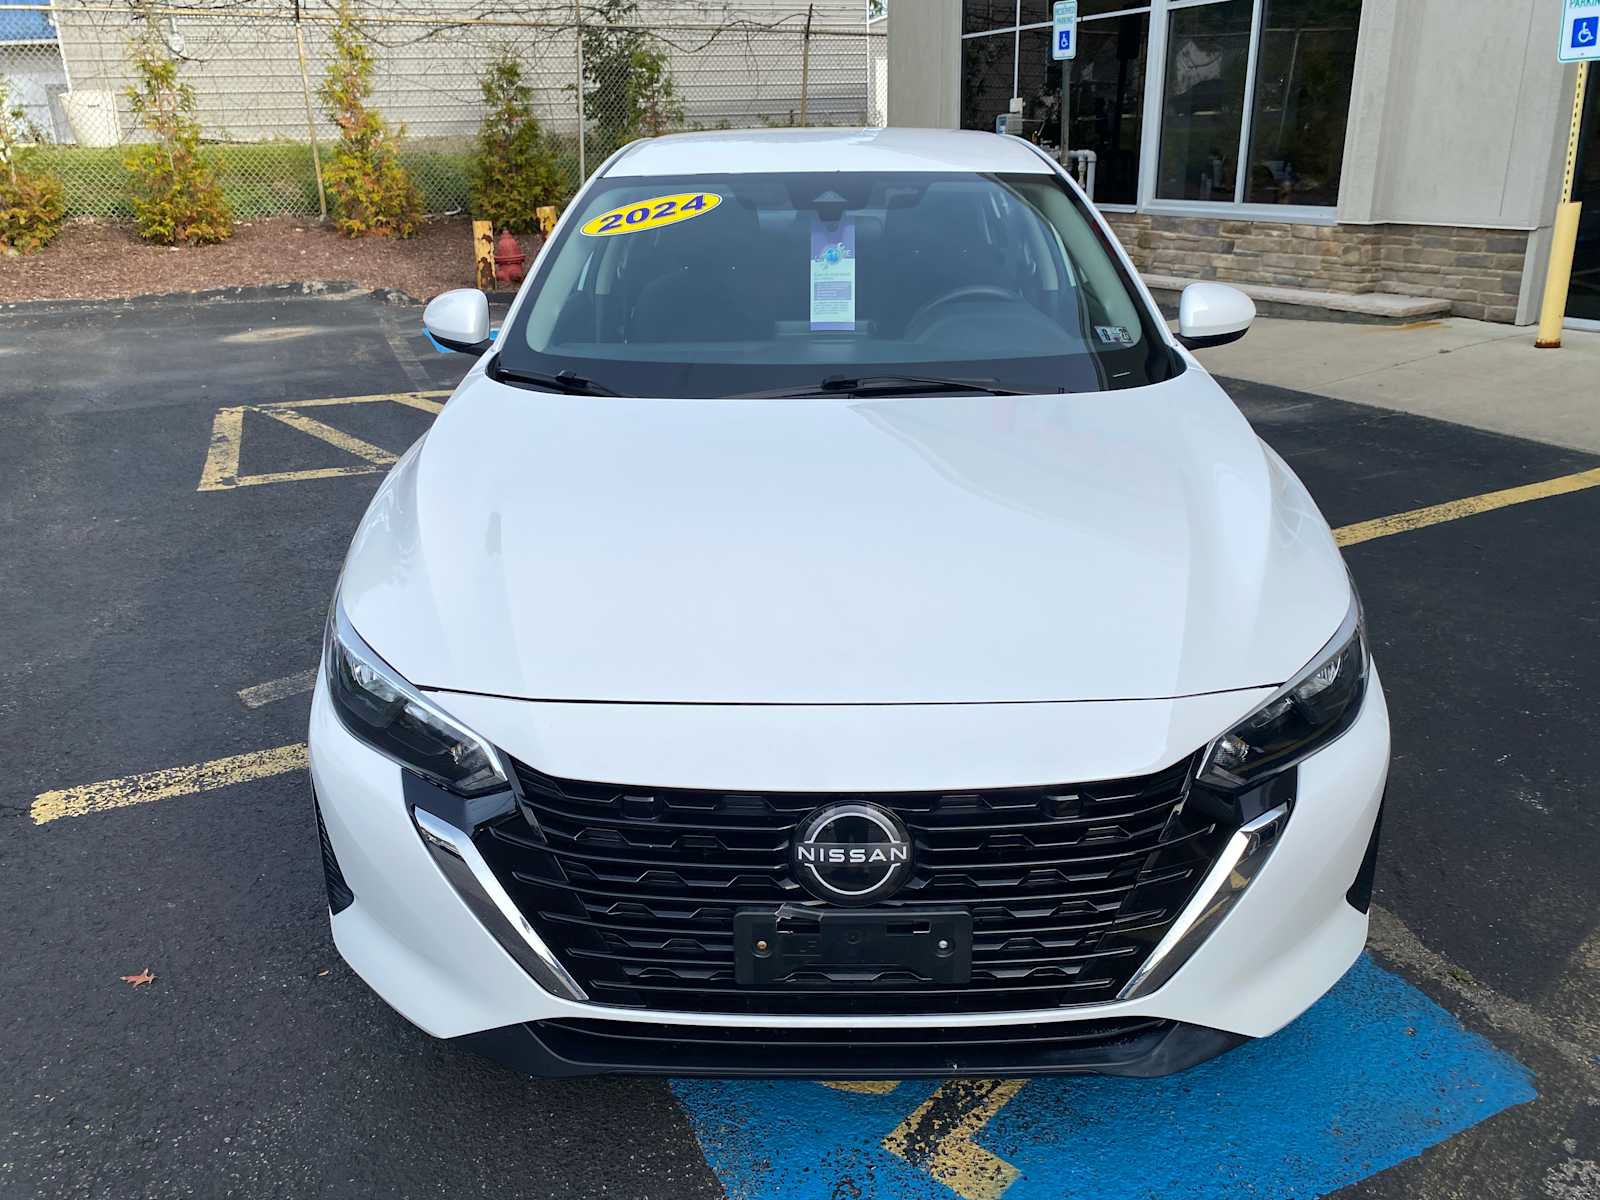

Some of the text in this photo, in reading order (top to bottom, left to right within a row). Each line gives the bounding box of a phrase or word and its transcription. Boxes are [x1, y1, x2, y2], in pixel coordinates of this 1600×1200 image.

[1569, 0, 1600, 8] PARKIN
[597, 194, 707, 233] 2024
[797, 846, 907, 863] NISSAN
